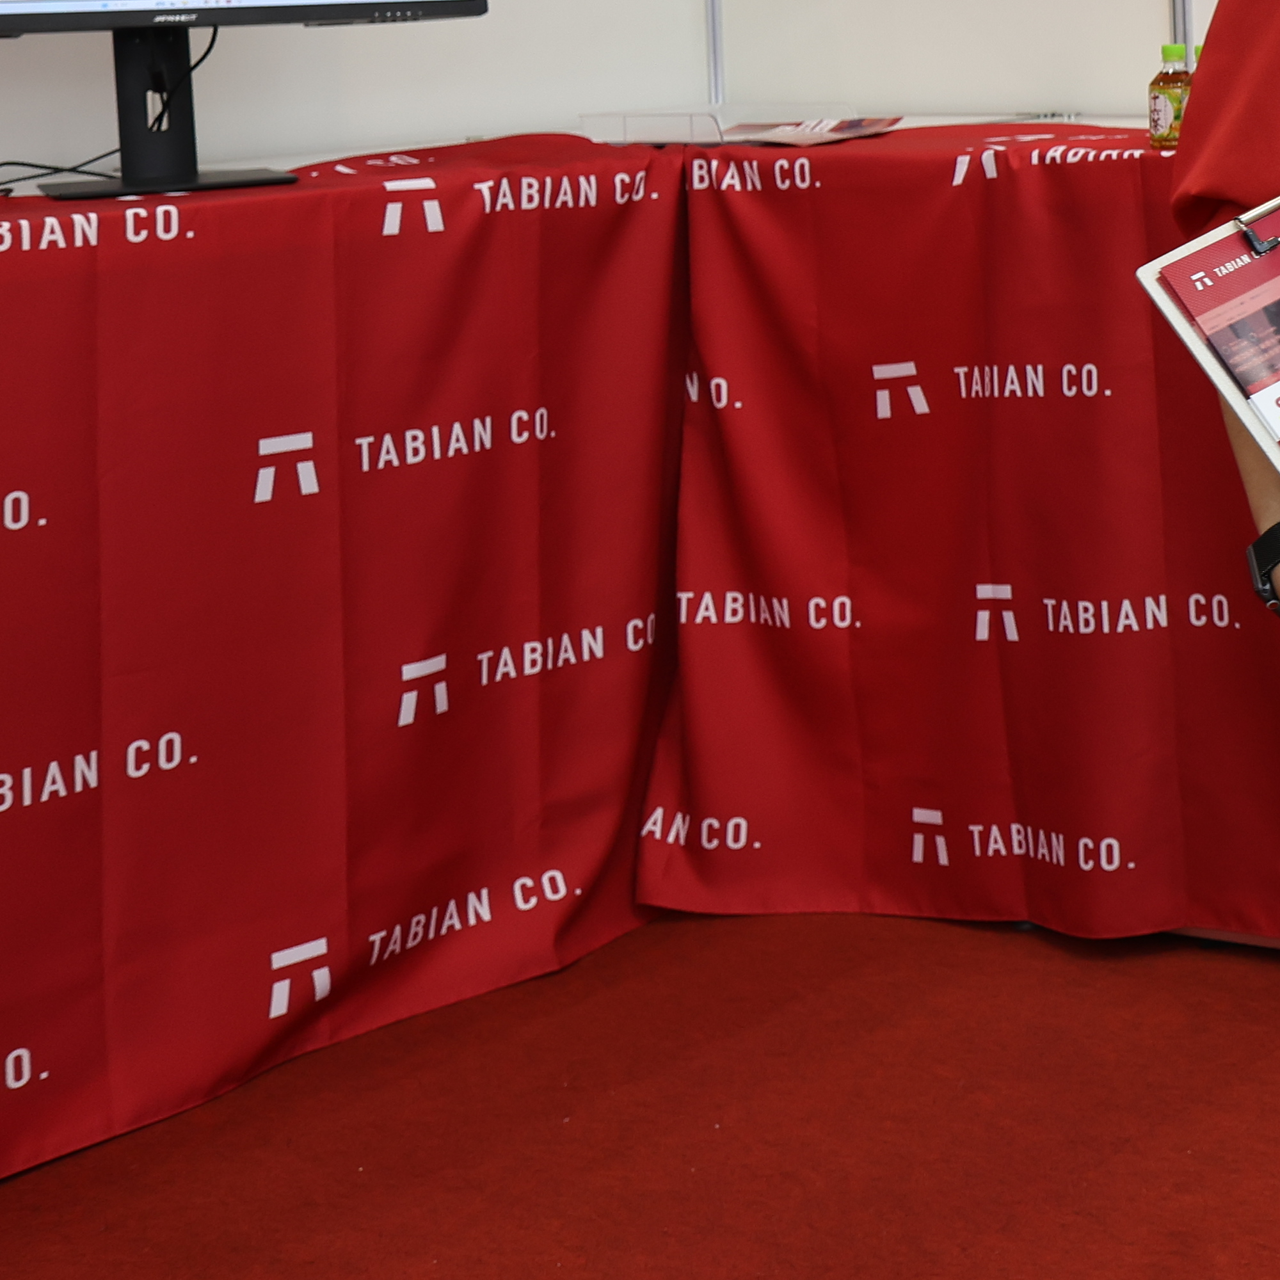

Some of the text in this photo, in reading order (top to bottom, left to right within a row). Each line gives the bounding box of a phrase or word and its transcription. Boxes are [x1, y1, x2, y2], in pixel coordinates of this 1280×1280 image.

[693, 157, 820, 191] BIAN CO.
[474, 175, 596, 213] TABIAN
[125, 204, 195, 243] CO.
[1212, 253, 1253, 278] TABIAN
[954, 364, 1111, 398] TABIAN CO.
[355, 408, 555, 472] TABIAN CO.
[677, 591, 861, 629] TABIAN CO.
[1043, 593, 1240, 633] TABIAN CO.
[478, 626, 603, 685] TABIAN
[127, 732, 197, 778] CO.
[702, 817, 761, 849] CO.
[969, 823, 1135, 871] TABIAN CO.
[369, 870, 581, 964] TABIAN CO.
